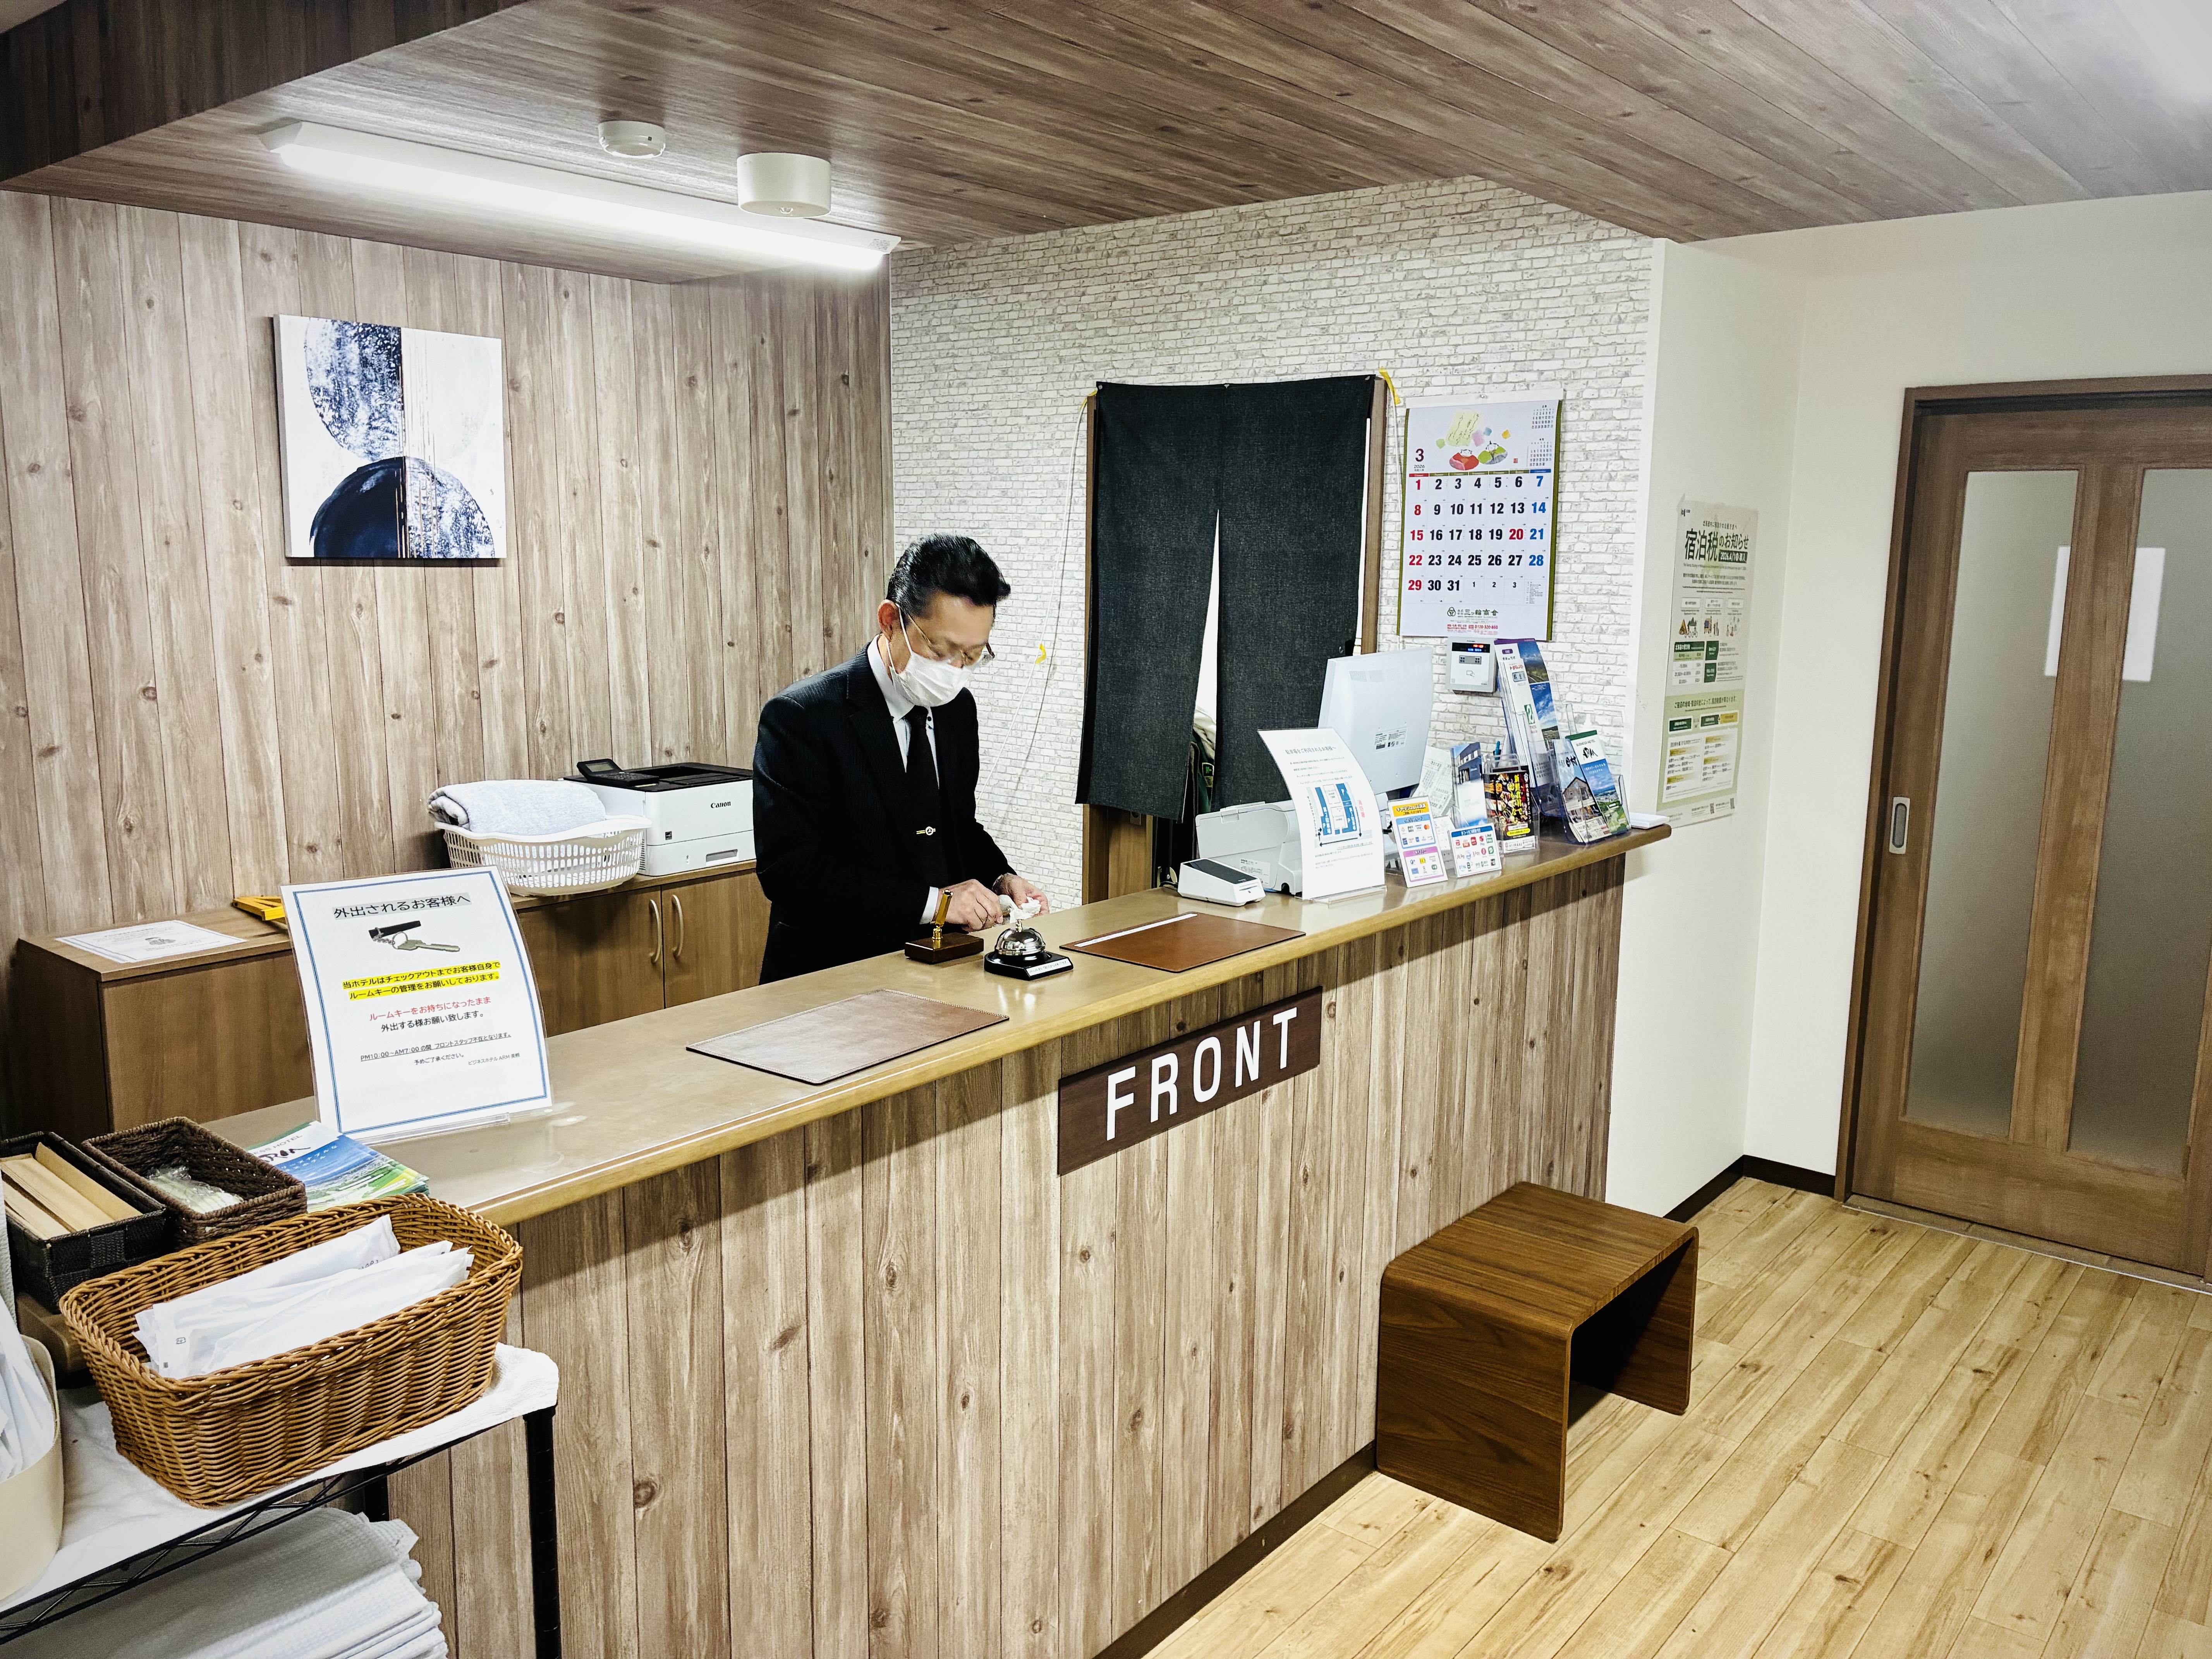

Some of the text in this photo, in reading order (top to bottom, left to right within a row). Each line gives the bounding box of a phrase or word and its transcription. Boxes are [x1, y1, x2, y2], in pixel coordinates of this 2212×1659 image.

[1415, 448, 1424, 462] 3
[1416, 476, 1544, 490] 1 2 3 4 5 6 7
[1414, 502, 1546, 515] 8 9 10 11 12 13 14
[1410, 528, 1544, 541] 15 16 17 18 19 20 21
[1409, 555, 1544, 566] 22 23 24 25 26 27 28
[1408, 580, 1422, 591] 29
[1427, 580, 1441, 591] 30
[1447, 580, 1460, 591] 31
[334, 895, 471, 919] 外出されるお客様へ
[342, 961, 501, 989] 当ホテルはチェックアウトまでお客様自身で
[349, 972, 500, 1000] ルームキーの管理をお願いしております。
[369, 996, 491, 1021] ルームキーをお持ちになったまま
[381, 1010, 483, 1032] 外出する様お願い致します。
[414, 1053, 464, 1065] 予めご了承ください。
[1106, 1007, 1297, 1141] FRONT
[273, 1135, 303, 1149] HOTEL
